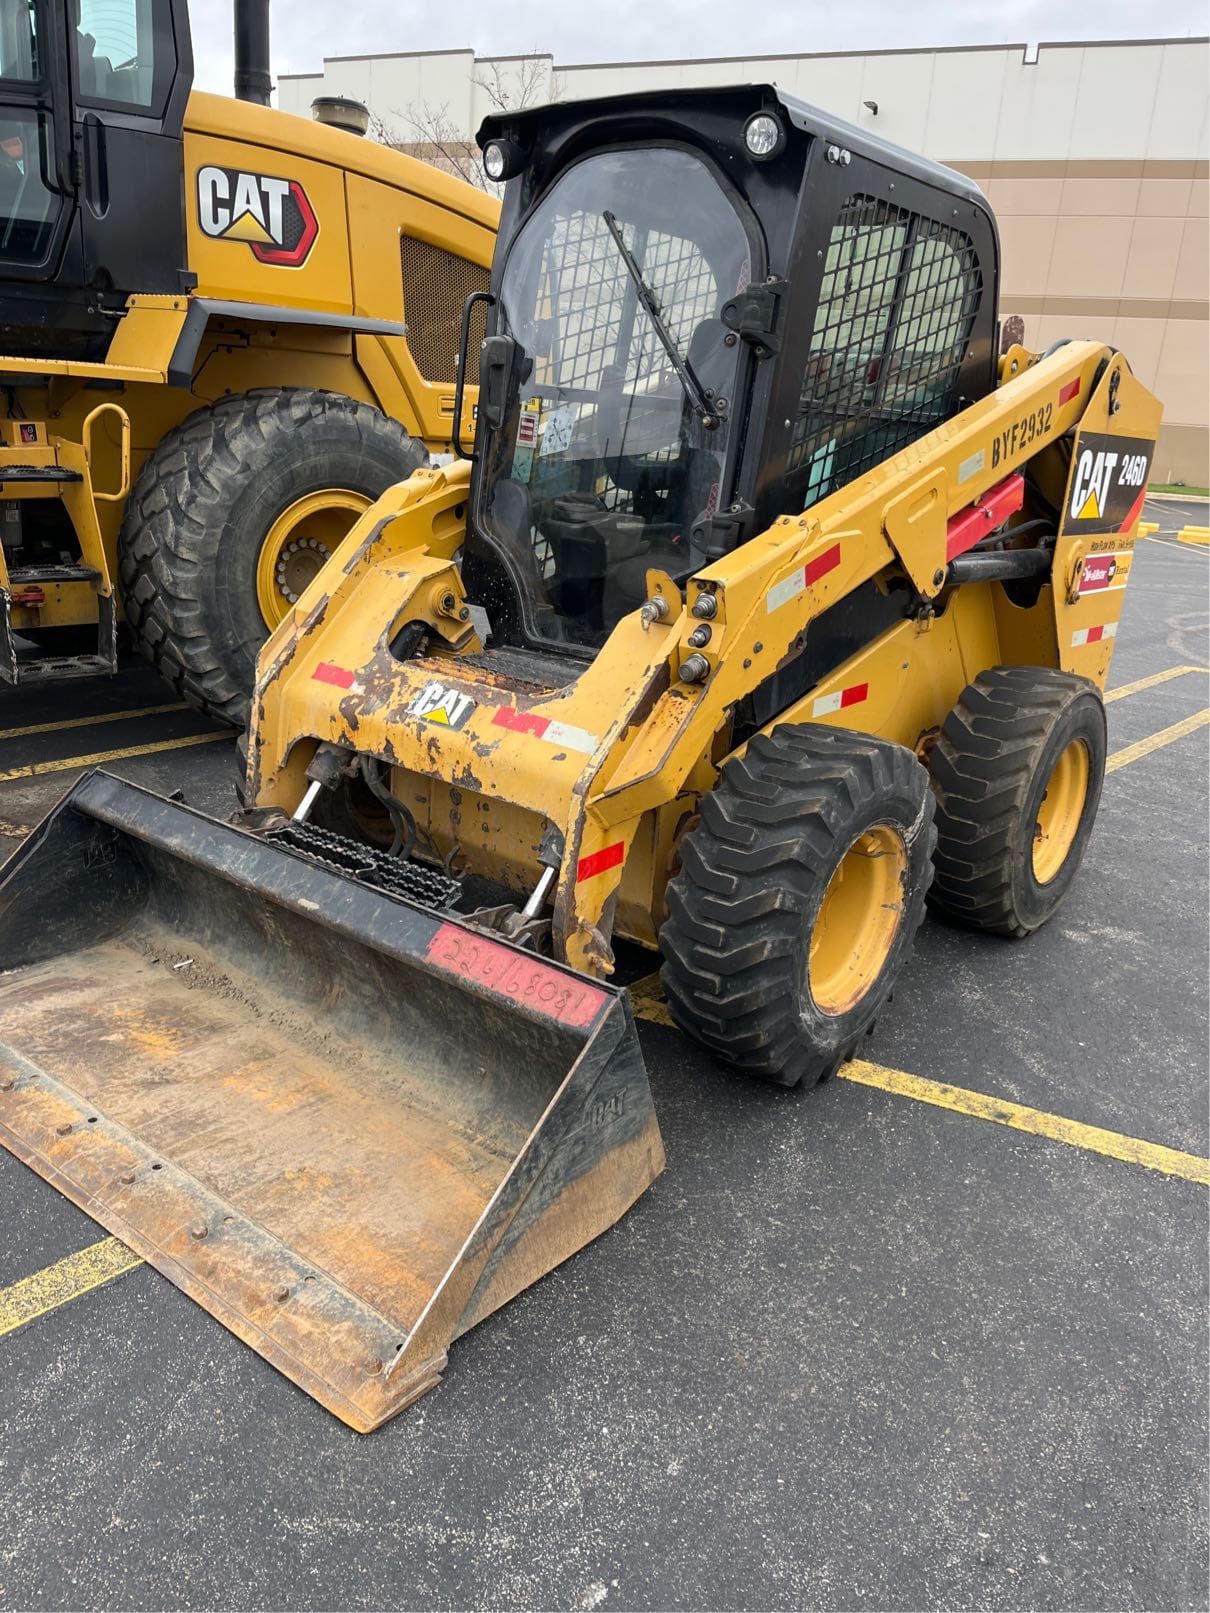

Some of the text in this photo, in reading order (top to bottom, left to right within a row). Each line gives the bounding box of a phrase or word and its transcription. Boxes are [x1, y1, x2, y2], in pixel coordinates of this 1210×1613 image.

[198, 166, 290, 245] CAT
[992, 402, 1053, 469] BYF2932
[1071, 449, 1148, 519] CAT 246D
[412, 680, 476, 726] CAT
